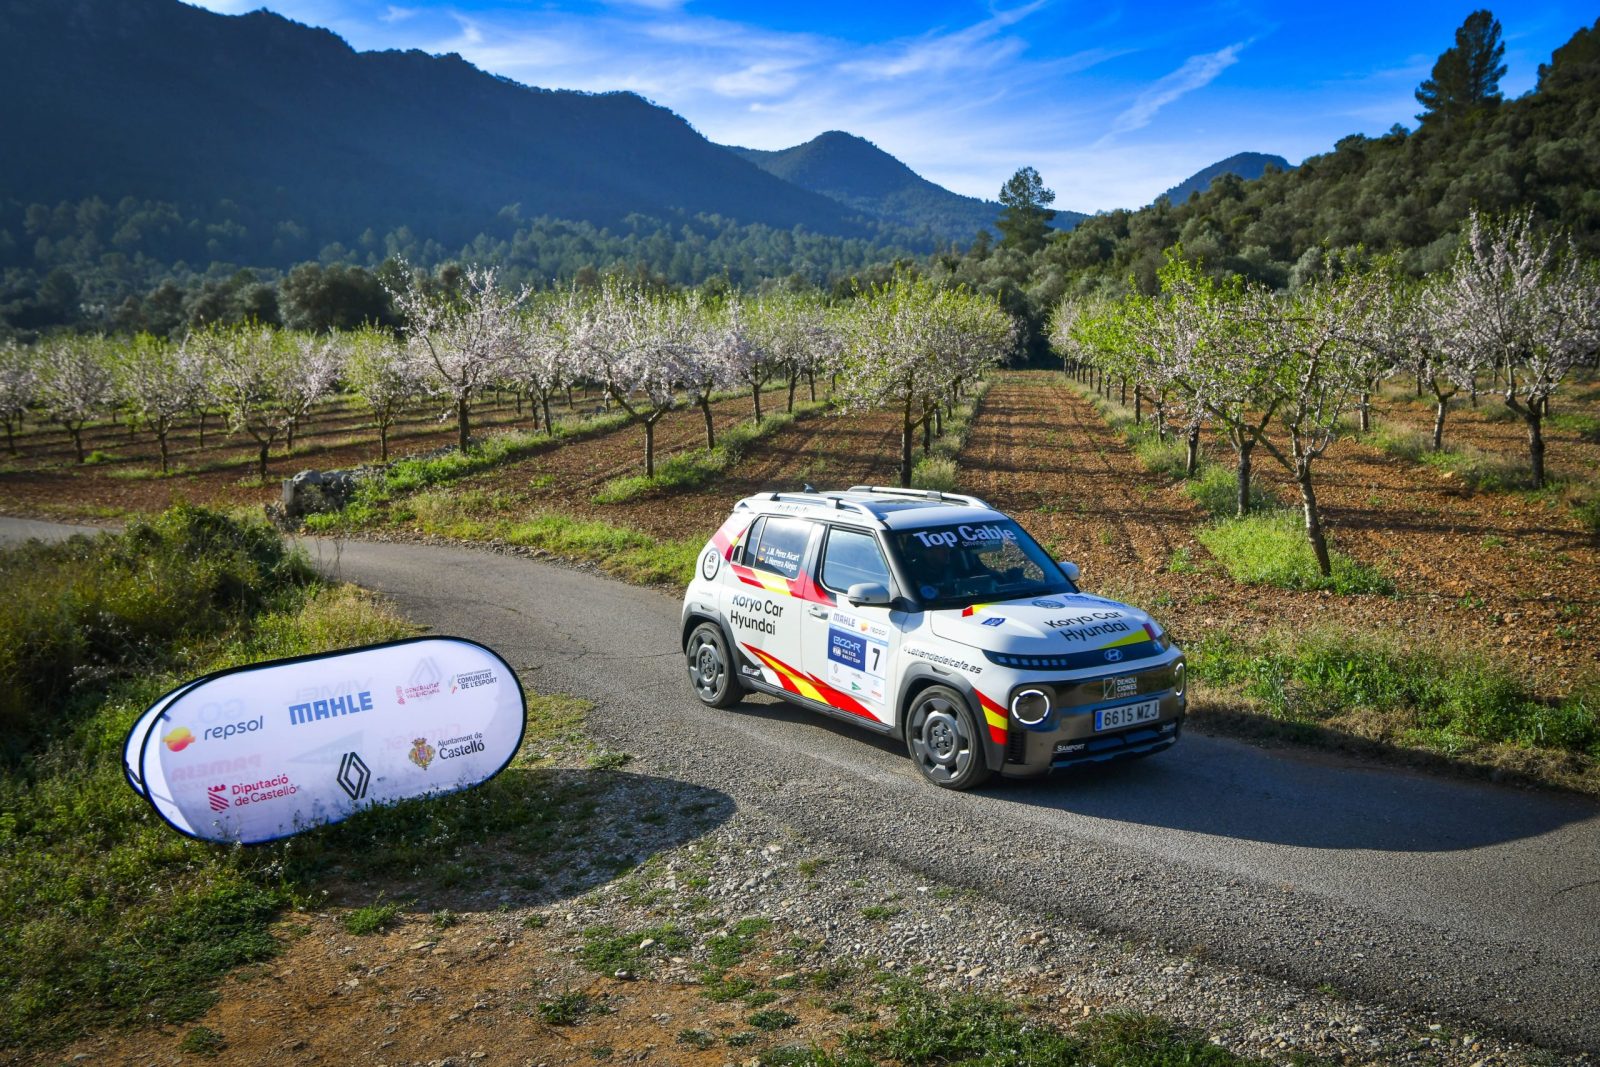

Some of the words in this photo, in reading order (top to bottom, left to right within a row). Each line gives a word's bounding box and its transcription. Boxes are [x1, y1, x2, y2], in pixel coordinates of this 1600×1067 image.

[912, 531, 958, 548] Top
[958, 525, 1017, 541] Cable
[732, 594, 762, 613] Koryo
[764, 600, 784, 617] Car
[730, 610, 776, 635] Hyundai
[833, 612, 856, 628] MAHLE
[1044, 614, 1092, 630] Koryo
[1092, 610, 1123, 621] Car
[1060, 619, 1130, 642] Hyundai
[872, 647, 881, 671] 7
[288, 691, 374, 725] MAHLE
[1104, 707, 1134, 727] 6615
[1136, 702, 1158, 720] MZJ
[204, 715, 264, 741] repsol
[437, 734, 473, 748] Ajuntament
[474, 731, 483, 739] de
[439, 739, 485, 760] Castelló
[231, 773, 289, 796] Diputació
[234, 795, 249, 807] de
[250, 783, 297, 803] Castelló
